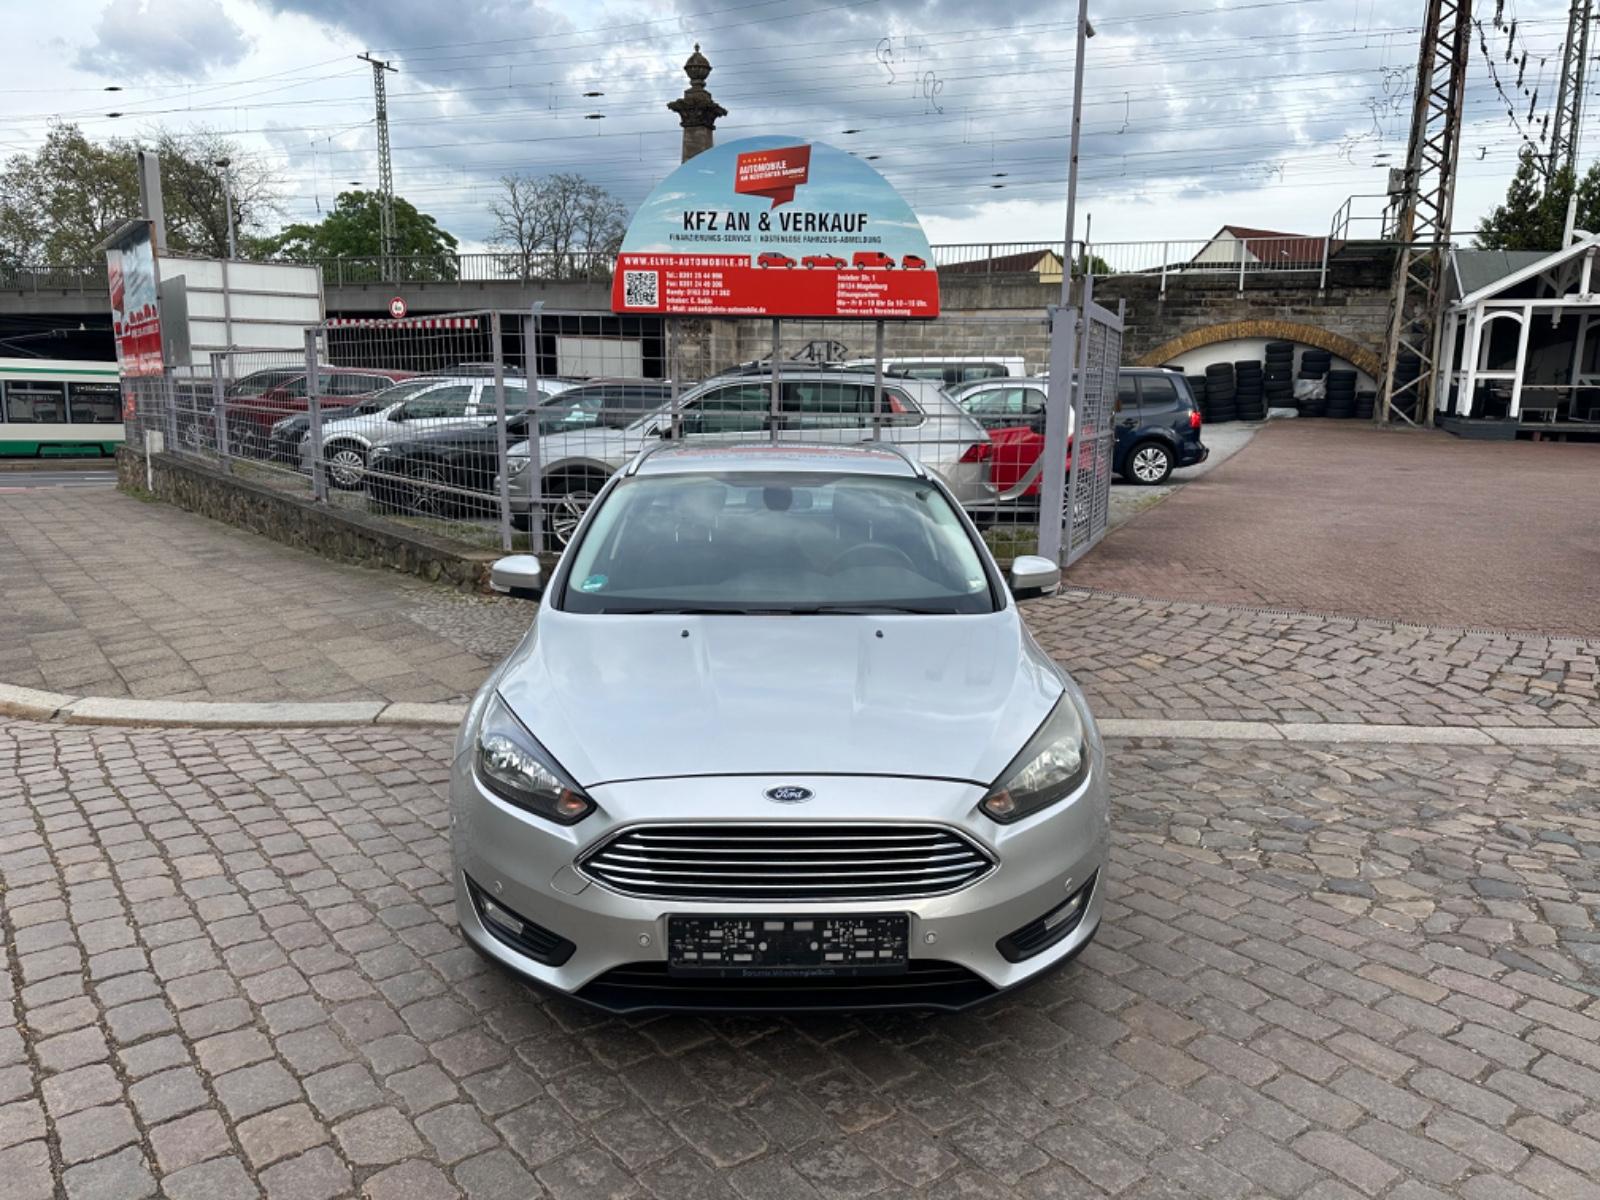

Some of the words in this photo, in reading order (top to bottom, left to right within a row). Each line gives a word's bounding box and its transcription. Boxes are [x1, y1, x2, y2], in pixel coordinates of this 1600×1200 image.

[739, 160, 787, 175] AUTOMOBILE
[684, 211, 717, 231] KFZ
[725, 212, 750, 231] AN
[758, 212, 771, 232] &
[779, 212, 868, 233] VERKAUF
[669, 234, 751, 242] FINANZIERUNGS-SERVICE
[803, 236, 882, 244] FAHRZEUG-ABMELDUNG
[623, 256, 750, 268] WWW.ELVIS-AUTOMOBILE.DE
[774, 788, 804, 799] Ford
